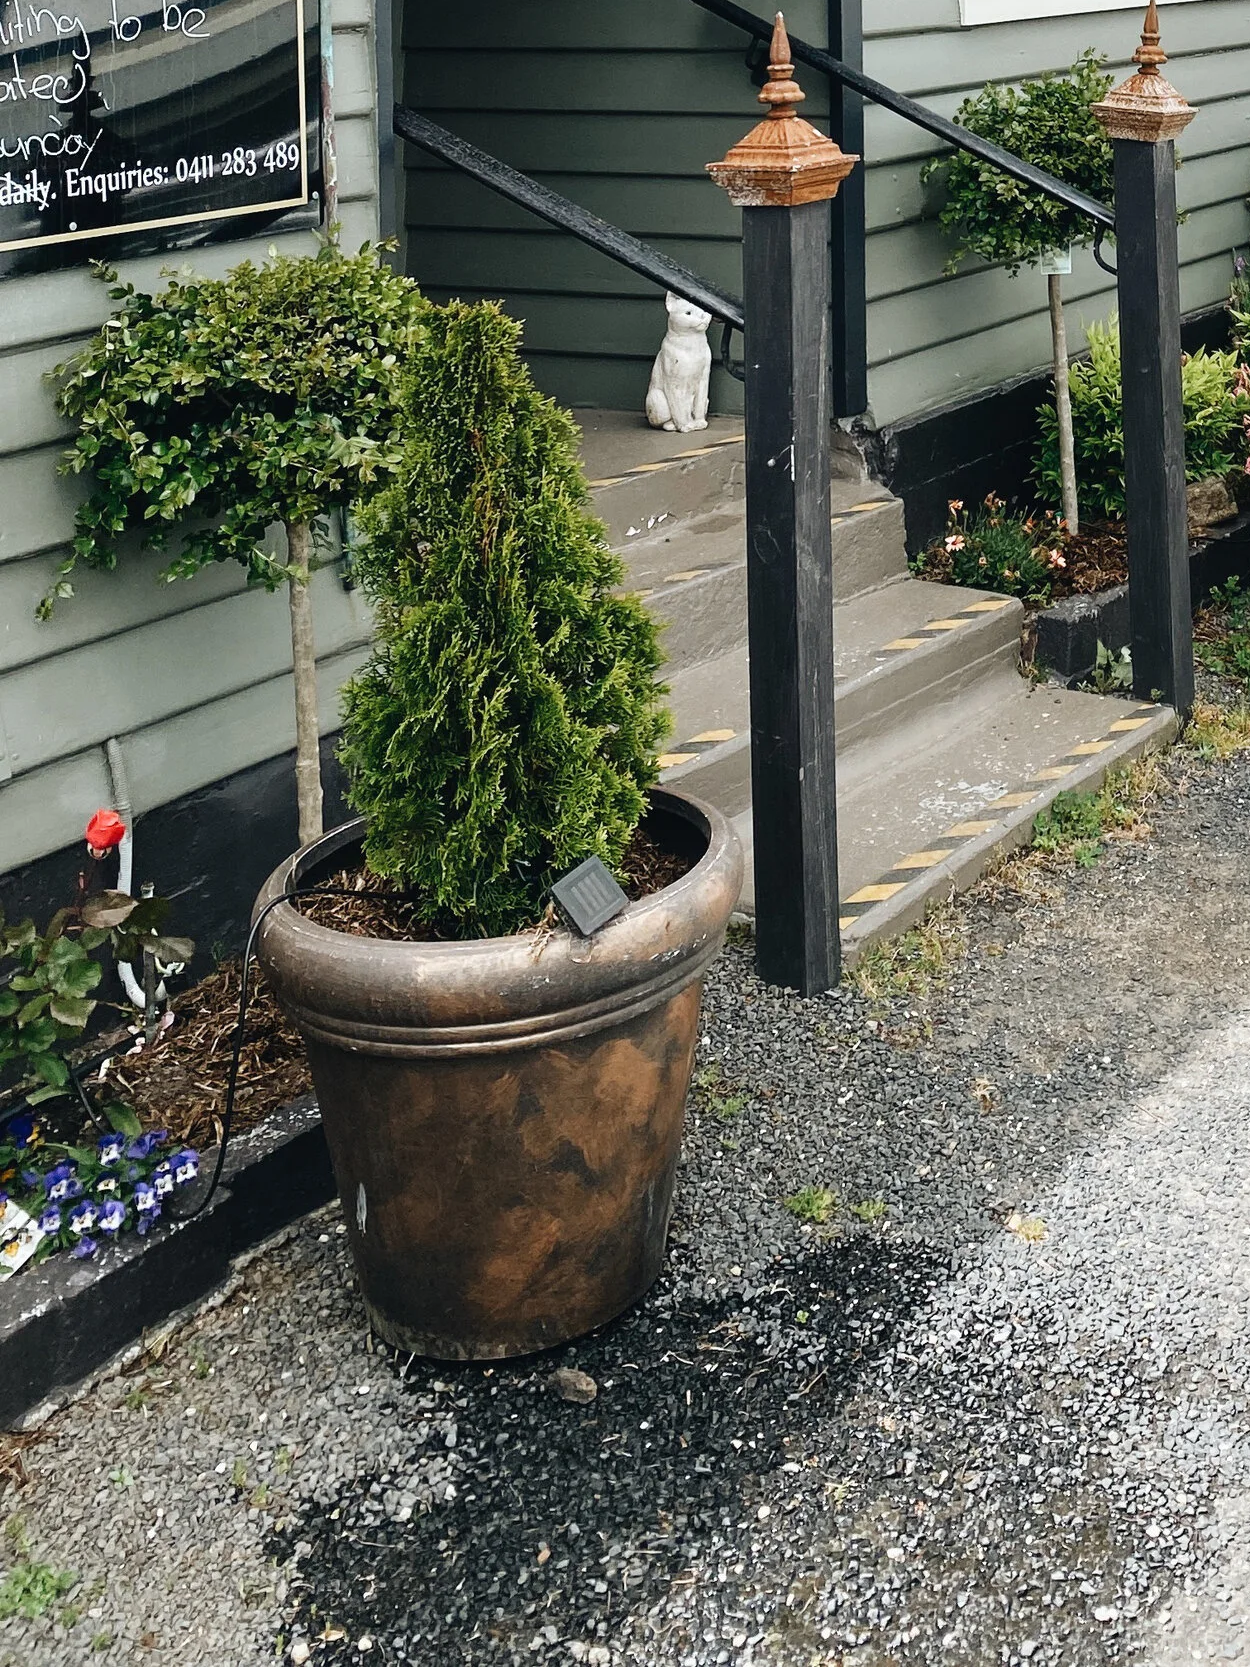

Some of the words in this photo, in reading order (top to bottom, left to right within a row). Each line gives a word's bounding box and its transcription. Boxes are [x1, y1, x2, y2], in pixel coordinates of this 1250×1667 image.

[65, 159, 169, 202] Enquiries:
[176, 155, 213, 184] 0411
[221, 147, 257, 177] 283
[263, 141, 299, 173] 489
